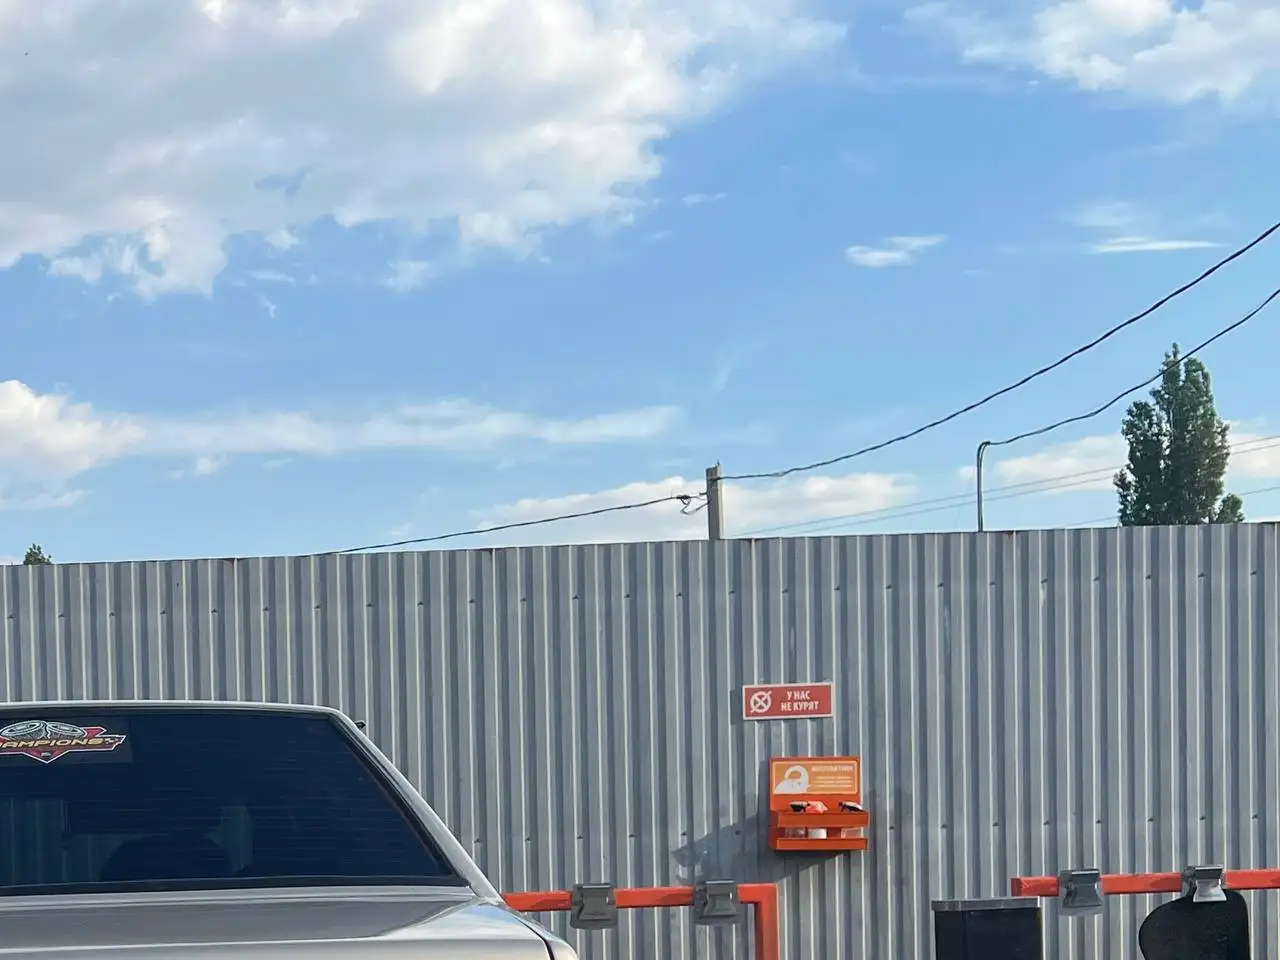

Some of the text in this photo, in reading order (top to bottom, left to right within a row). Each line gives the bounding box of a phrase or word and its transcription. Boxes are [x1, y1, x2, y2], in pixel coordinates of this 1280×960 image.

[786, 690, 811, 700] У НАС
[780, 701, 819, 711] НЕ КУРЯТ
